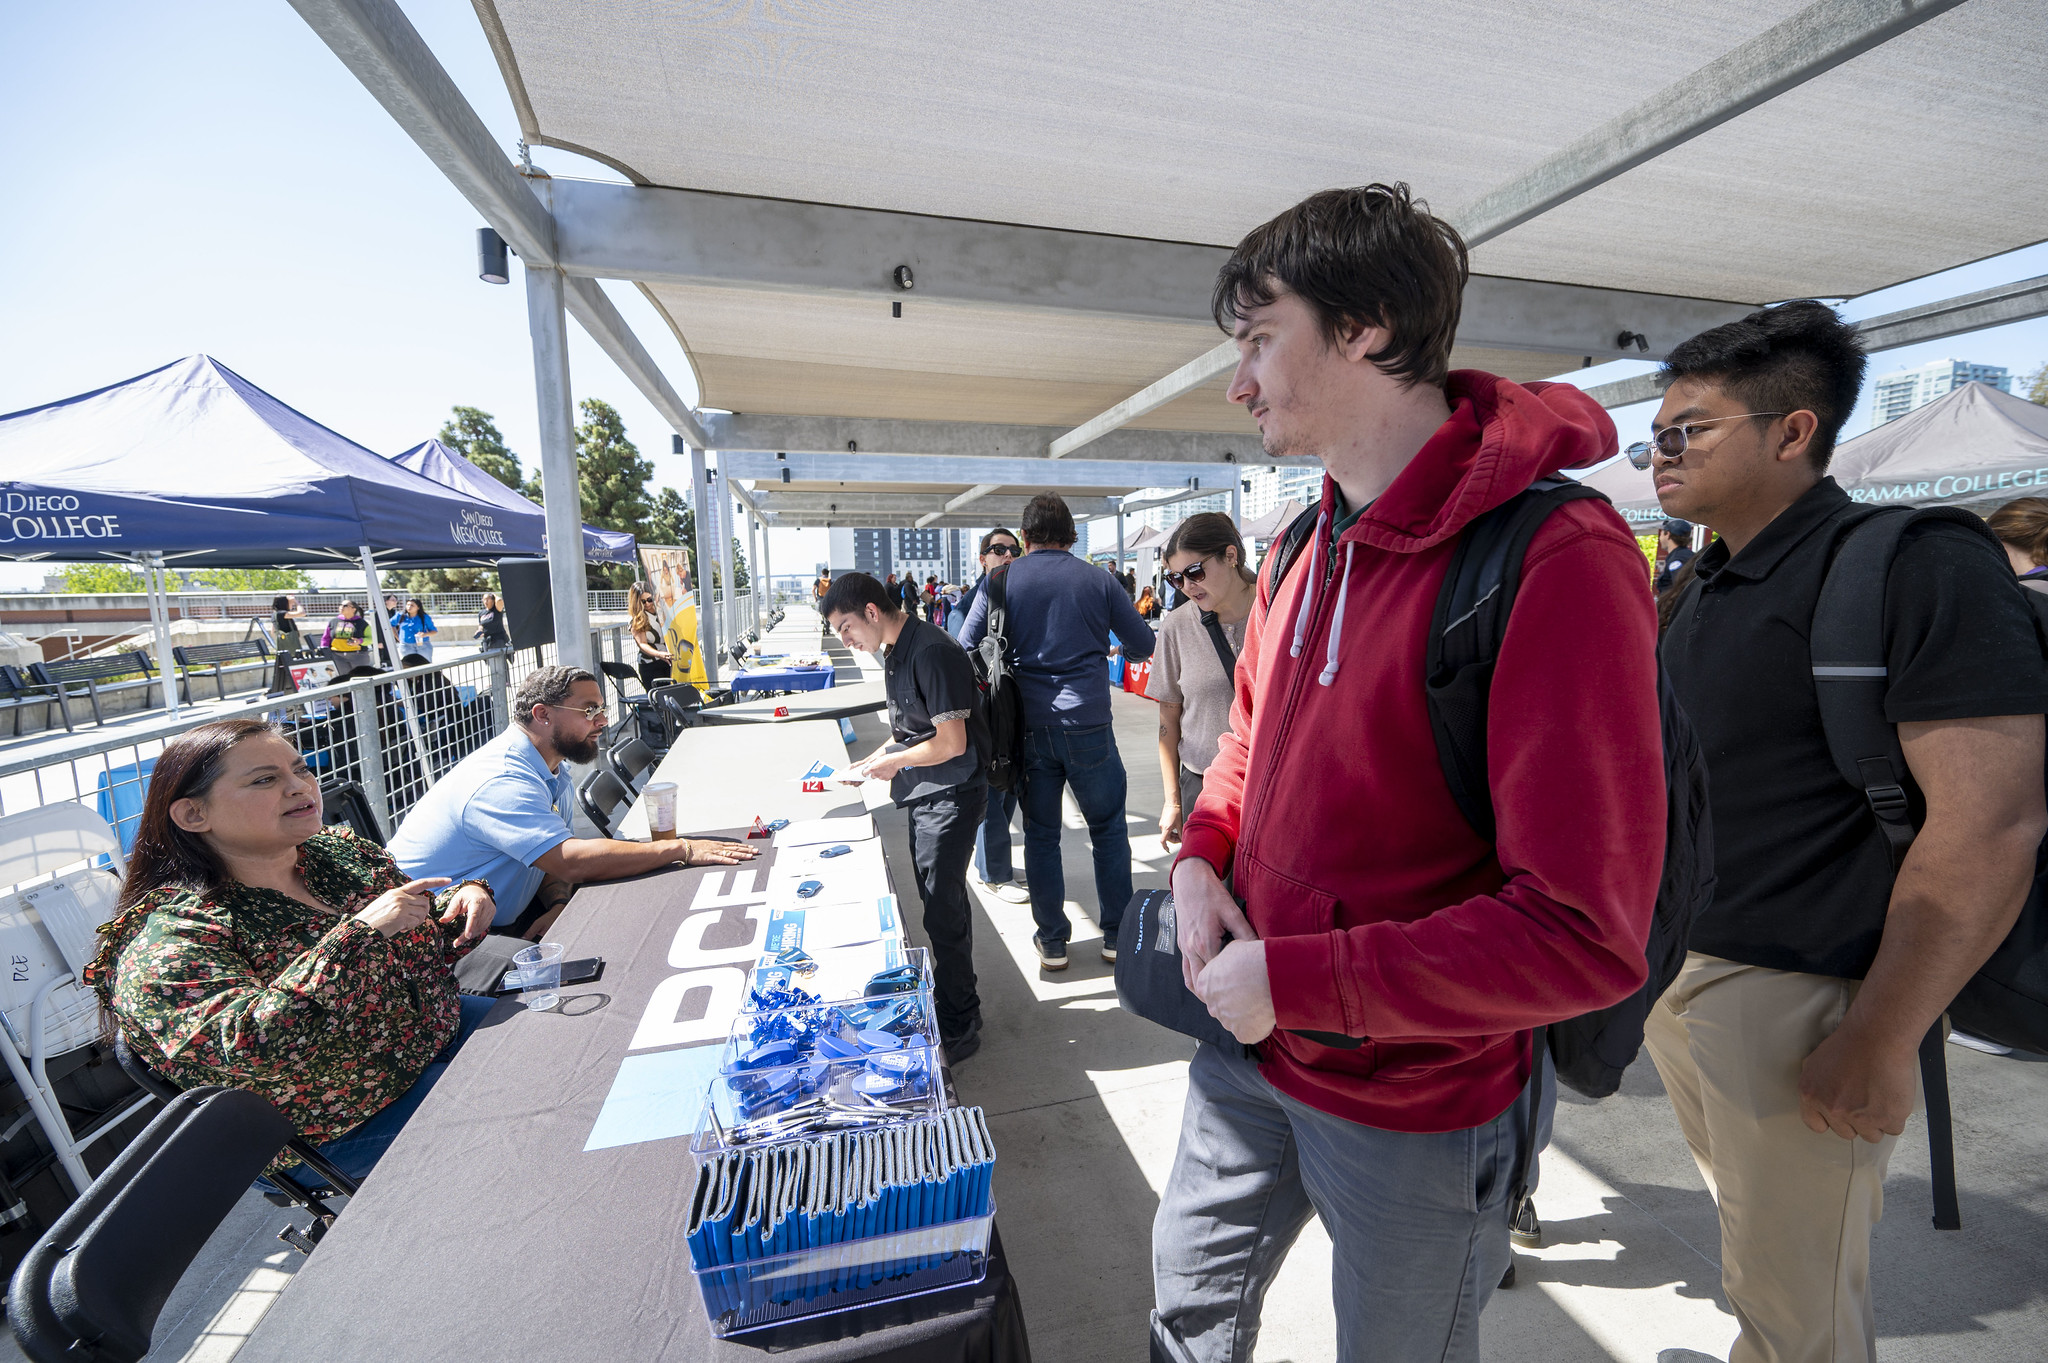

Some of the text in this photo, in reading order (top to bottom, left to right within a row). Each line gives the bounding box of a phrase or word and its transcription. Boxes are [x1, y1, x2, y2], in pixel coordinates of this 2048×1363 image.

[1934, 467, 2048, 498] COLLEGE
[6, 492, 80, 513] DIEGO
[461, 508, 494, 527] SAN DIEGO
[1618, 507, 1674, 522] COLLEG
[450, 521, 507, 547] MESA COLLEGE
[778, 708, 788, 716] 13
[805, 781, 819, 791] 12
[781, 922, 798, 951] HIRING
[628, 869, 770, 1050] DCE
